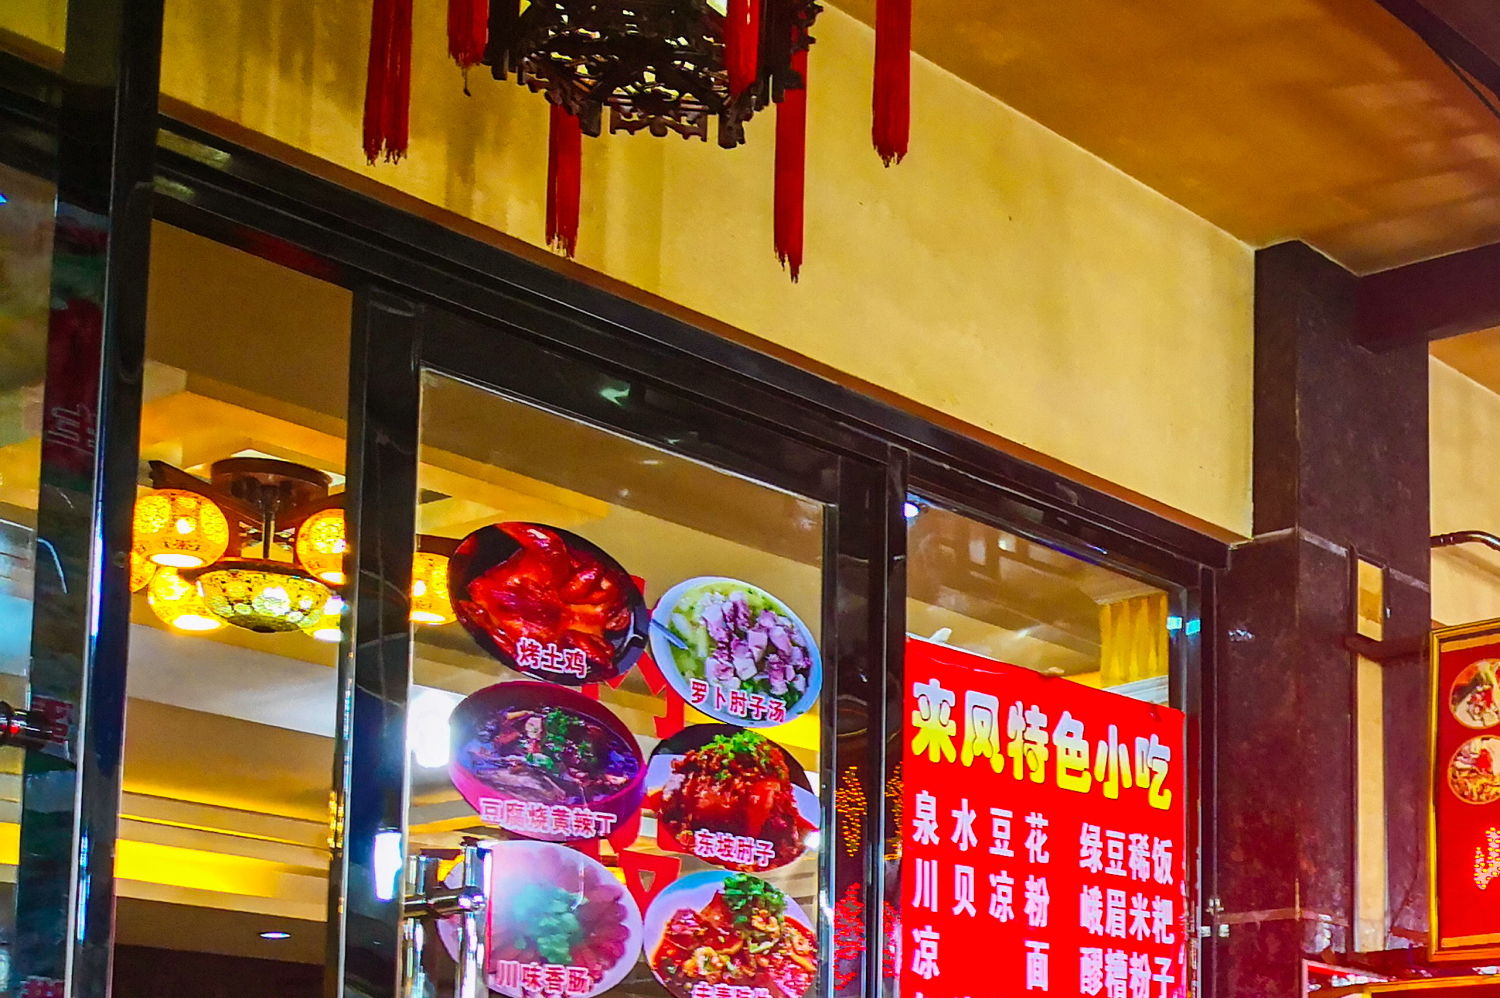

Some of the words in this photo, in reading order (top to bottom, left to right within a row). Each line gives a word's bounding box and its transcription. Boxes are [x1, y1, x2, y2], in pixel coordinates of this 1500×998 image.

[516, 638, 588, 678] 烤土鸡
[690, 679, 787, 724] 罗卜肘子汤
[911, 678, 1172, 811] 来凤特色小吃
[693, 829, 775, 866] 东坡肘子
[912, 789, 1049, 864] 泉水豆花
[1079, 822, 1174, 886] 绿豆稀饭
[912, 858, 1050, 928] 川贝凉粉
[1079, 884, 1174, 944] 峨眉米粑
[497, 961, 593, 995] 川味香肠
[912, 925, 1050, 992] 凉面
